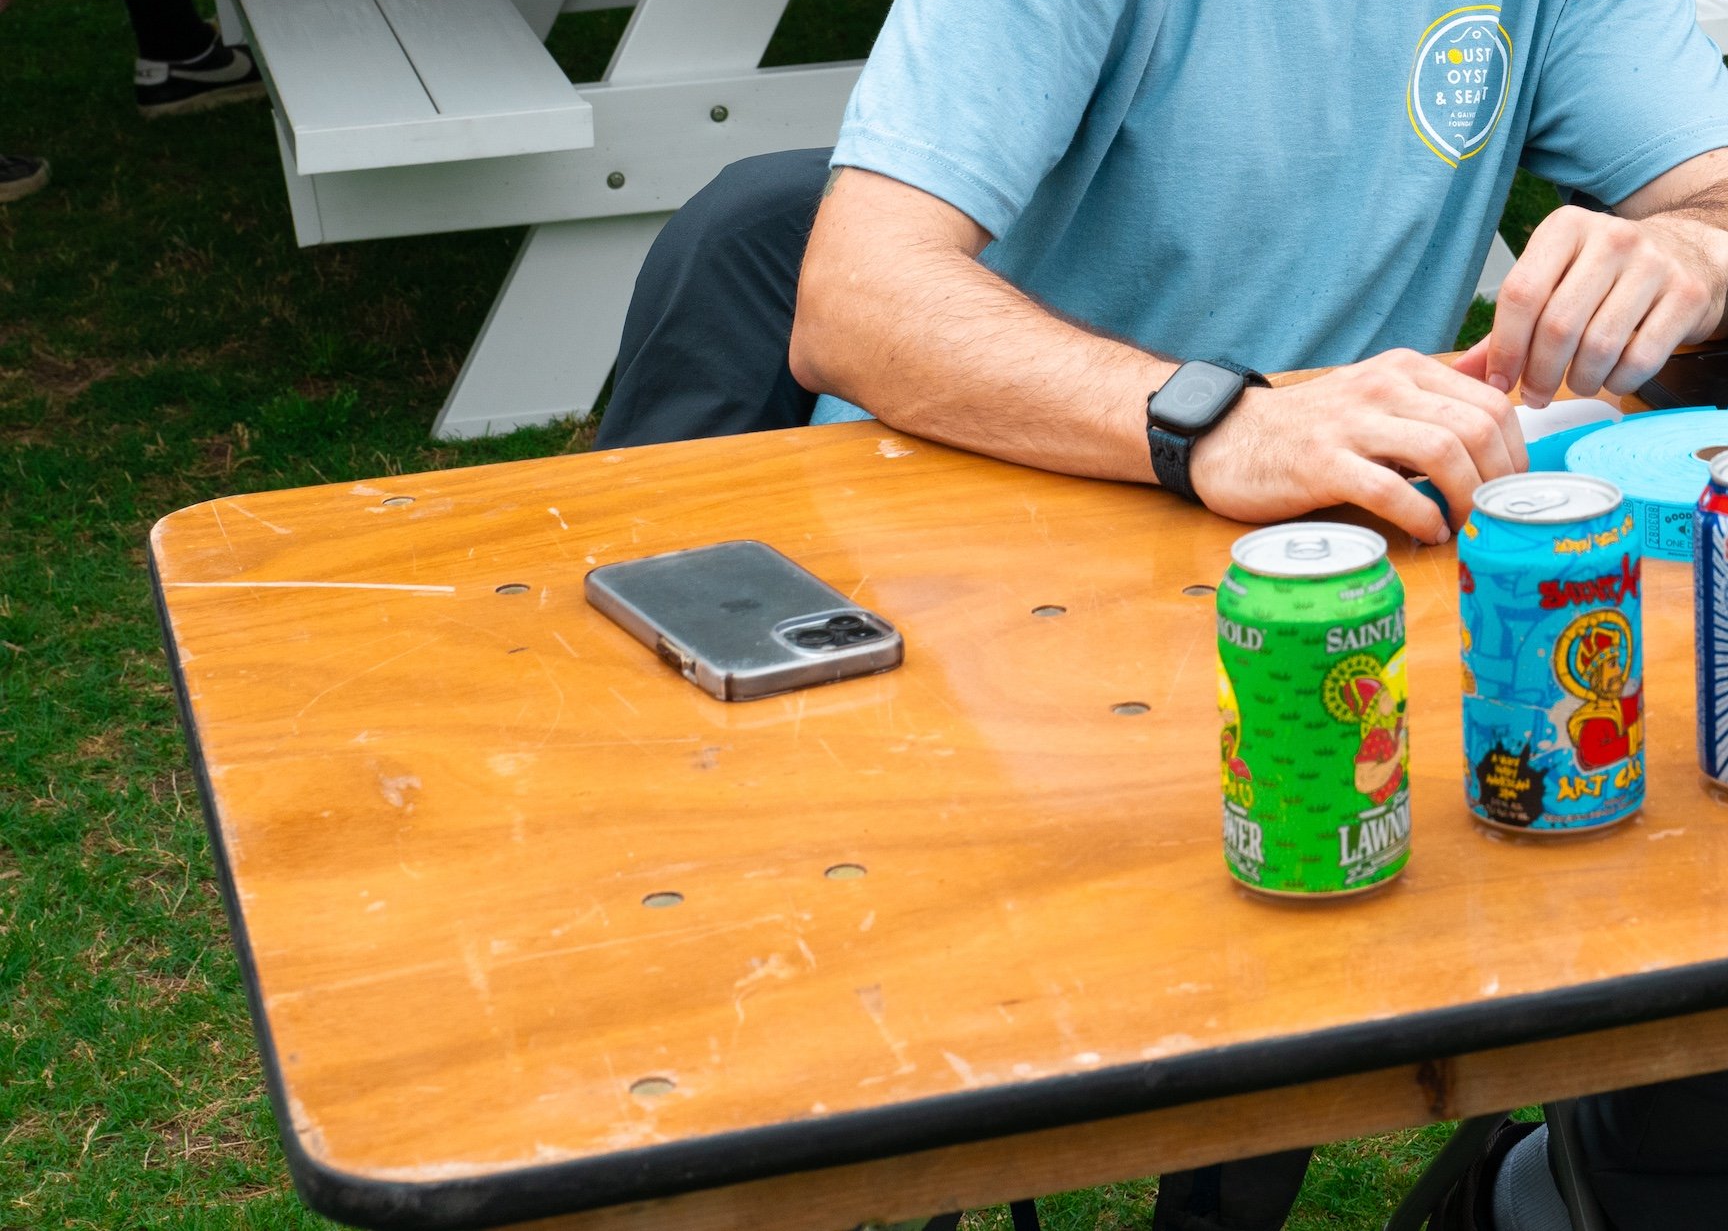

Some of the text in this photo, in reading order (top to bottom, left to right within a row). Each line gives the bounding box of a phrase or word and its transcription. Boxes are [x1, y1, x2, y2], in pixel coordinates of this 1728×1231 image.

[1436, 48, 1492, 65] HOUST
[1447, 70, 1487, 84] OYST
[1436, 92, 1446, 105] &
[1665, 512, 1693, 524] GOOD
[1666, 539, 1685, 548] ONE
[1538, 574, 1621, 609] SAINT
[1217, 614, 1263, 650] NOLD
[1326, 620, 1393, 654] SAINT
[1557, 775, 1608, 801] ART
